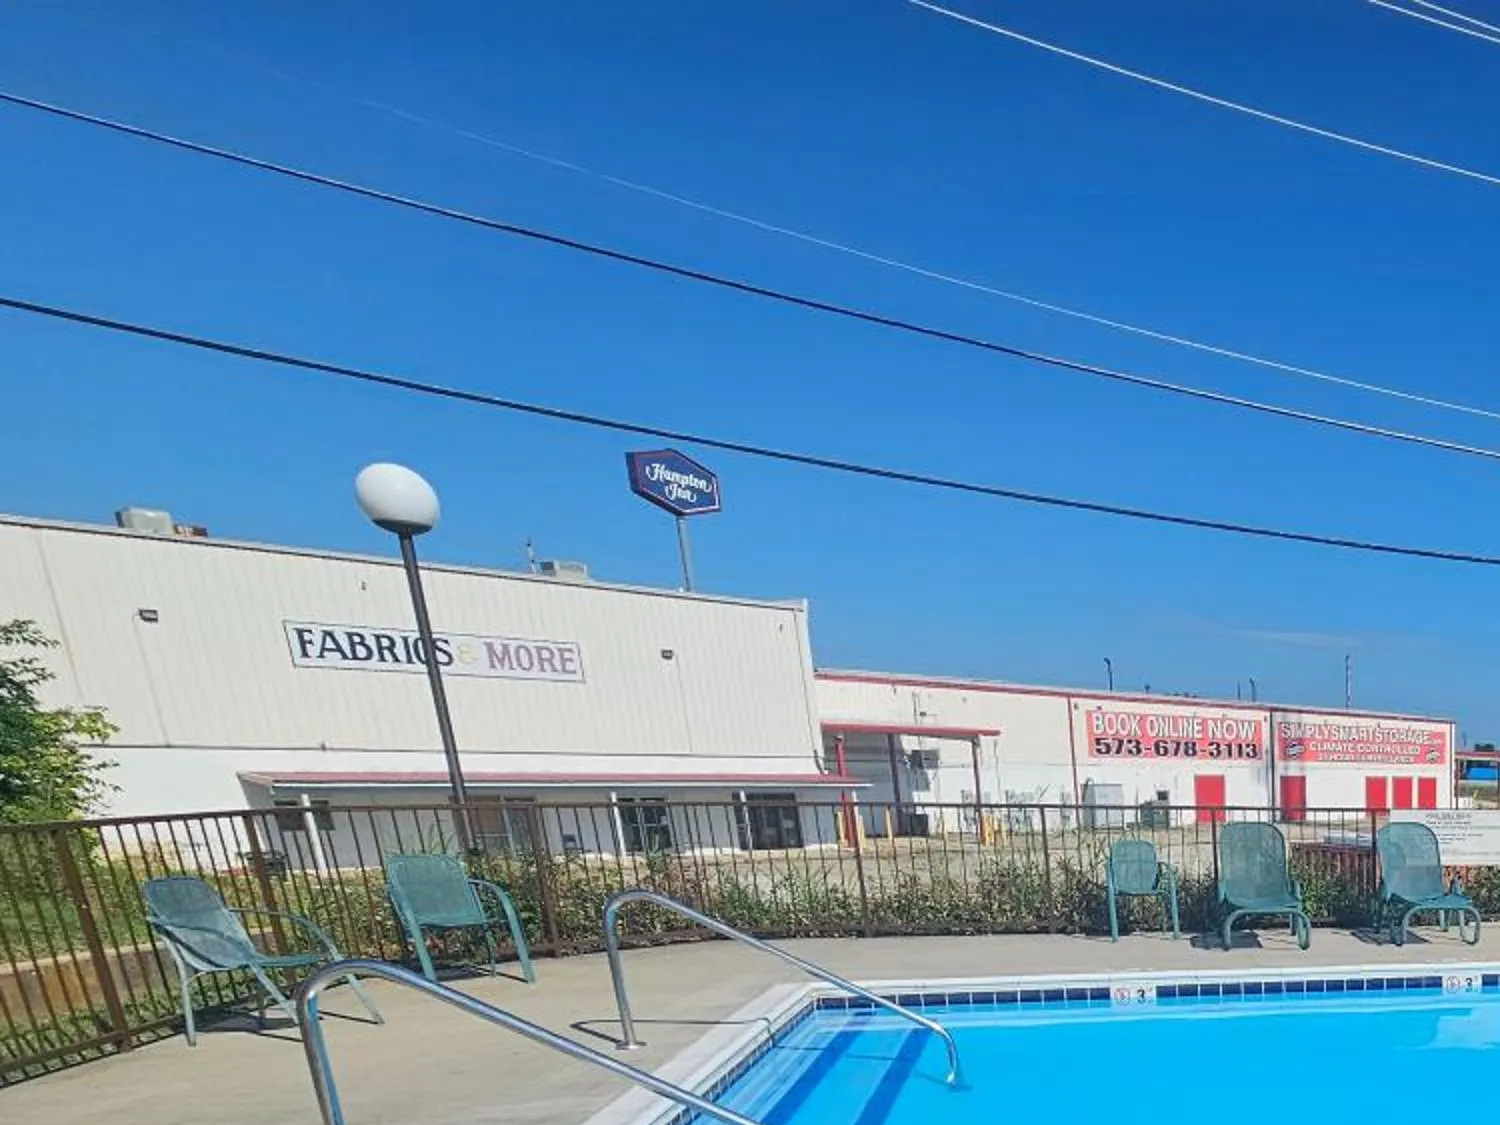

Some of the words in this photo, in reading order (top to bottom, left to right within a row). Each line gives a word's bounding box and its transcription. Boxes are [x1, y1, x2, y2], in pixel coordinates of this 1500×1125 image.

[645, 463, 712, 492] Hampton
[664, 483, 697, 503] Inn
[293, 628, 454, 667] FABRICS
[483, 642, 577, 675] MORE
[1093, 712, 1141, 737] BOOK
[1146, 715, 1203, 739] ONLINE
[1208, 719, 1256, 741] NOW
[1094, 737, 1258, 759] 573-678-3113
